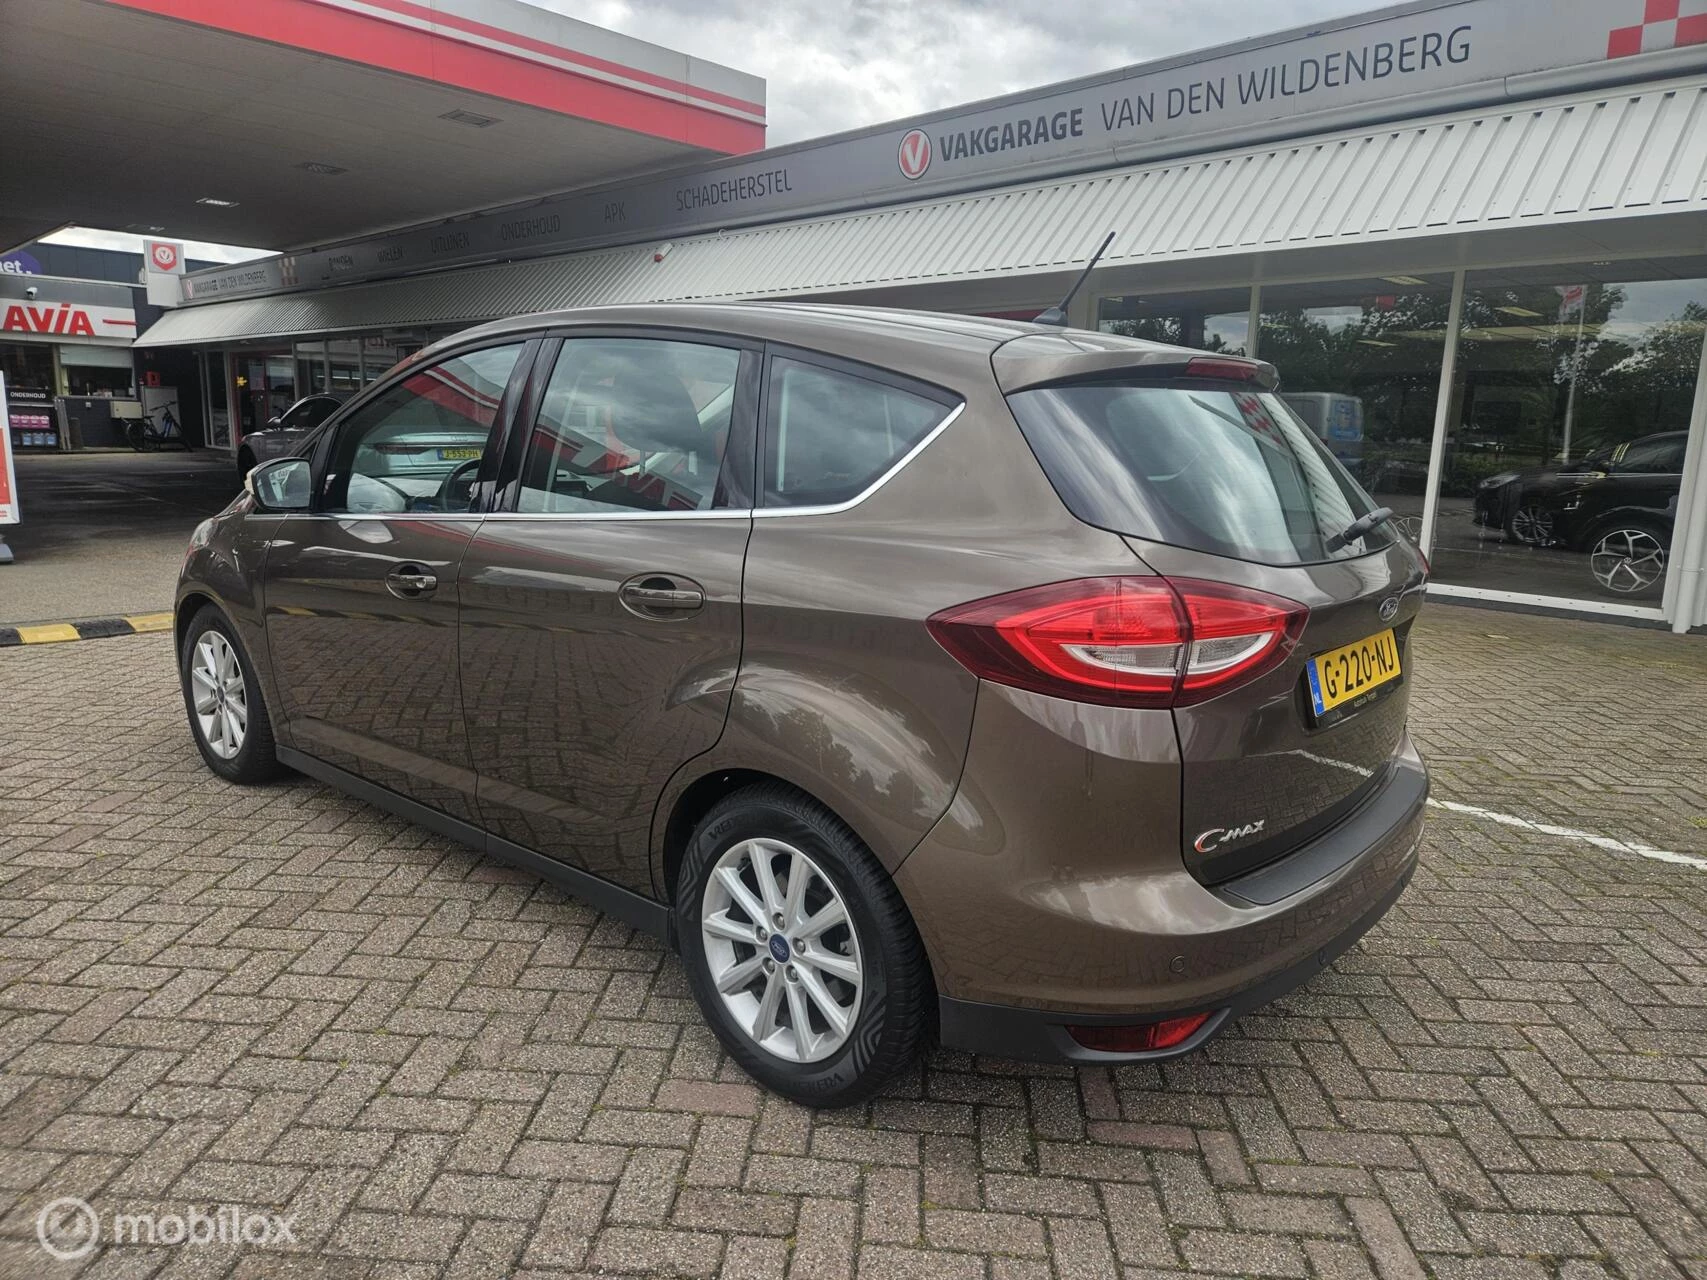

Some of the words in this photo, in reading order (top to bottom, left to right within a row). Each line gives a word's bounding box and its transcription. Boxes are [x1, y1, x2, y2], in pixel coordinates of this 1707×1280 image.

[940, 108, 1083, 162] VAKGARAGE
[1101, 92, 1155, 132] VAN
[1167, 77, 1225, 121] DEN
[1237, 25, 1472, 105] WILDENBERG
[676, 168, 793, 212] SCHADEHERSTEL
[501, 214, 561, 241] ONDERHOUD
[604, 201, 626, 225] APK
[10, 391, 46, 399] ONDERHOUD
[1324, 636, 1394, 699] G-220-NJ
